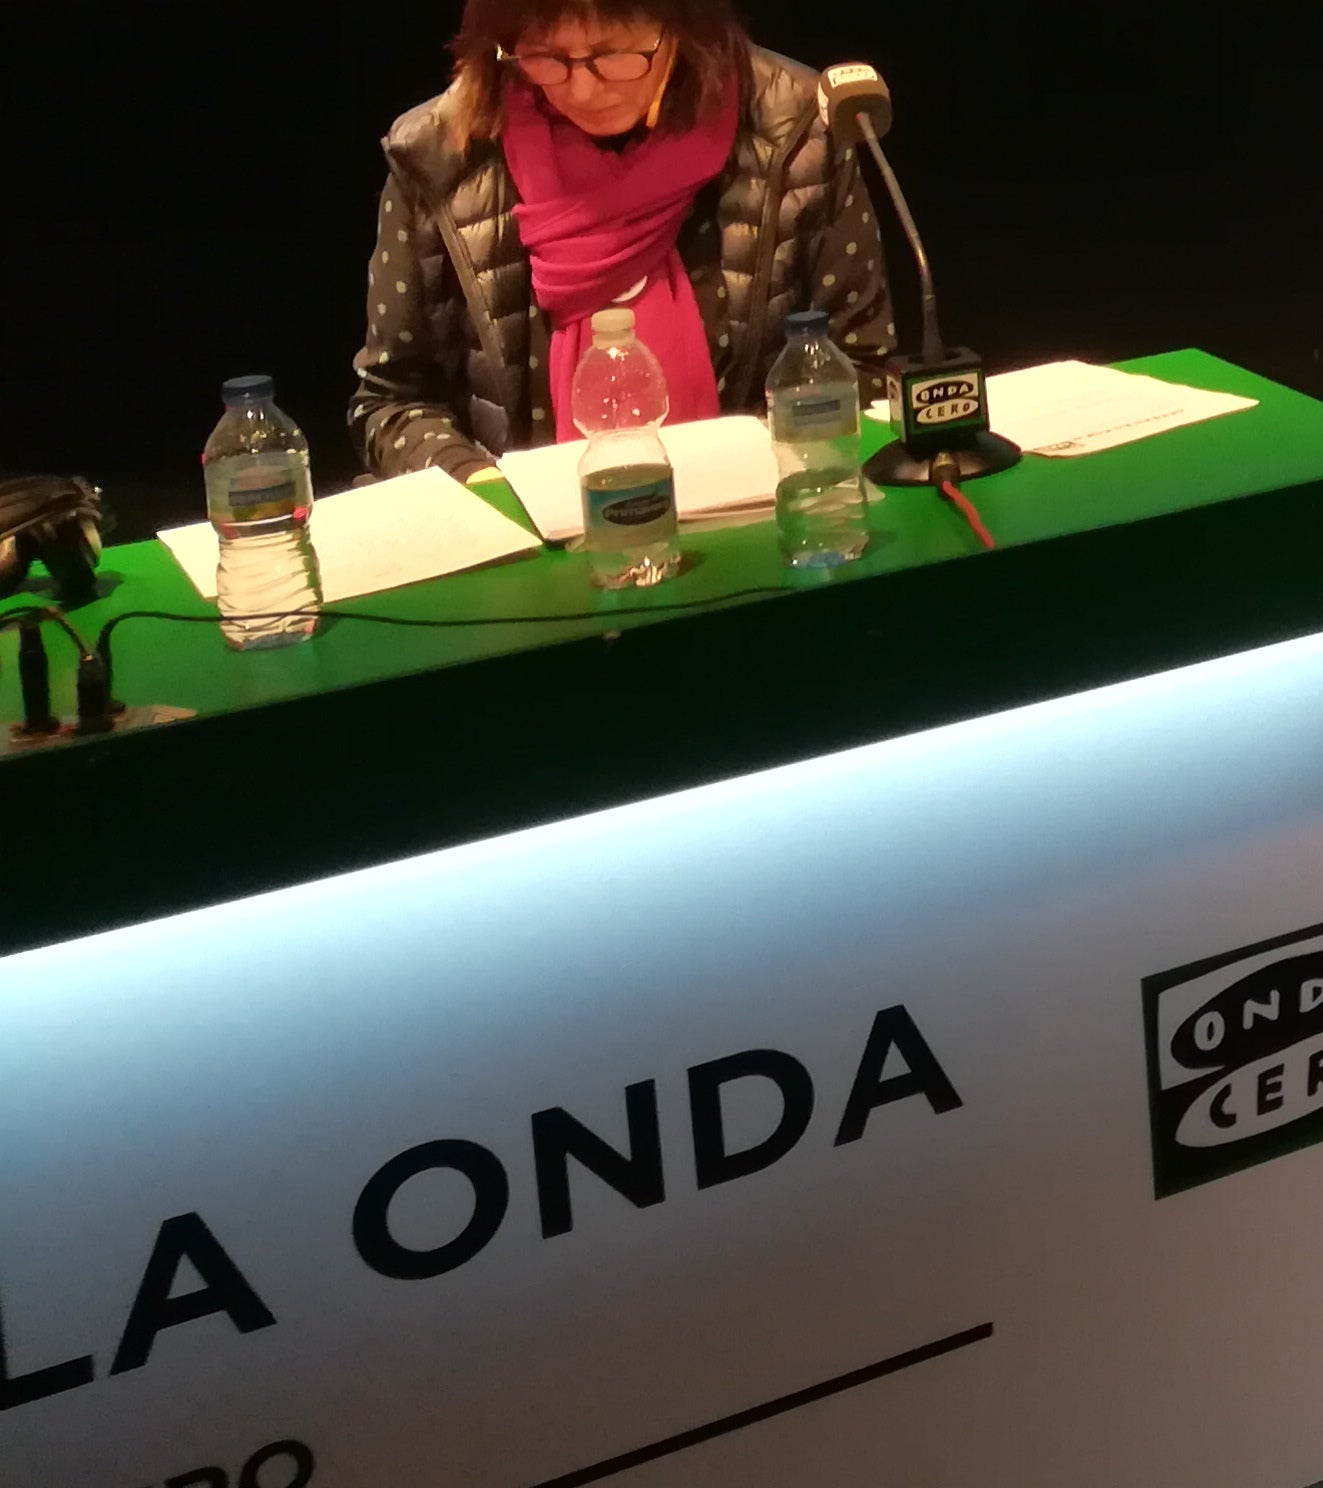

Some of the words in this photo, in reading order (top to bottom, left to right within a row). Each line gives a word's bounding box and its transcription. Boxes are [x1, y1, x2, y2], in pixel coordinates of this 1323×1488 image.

[920, 383, 970, 401] ONDA
[925, 402, 971, 419] CERO
[351, 1003, 964, 1281] ONDA
